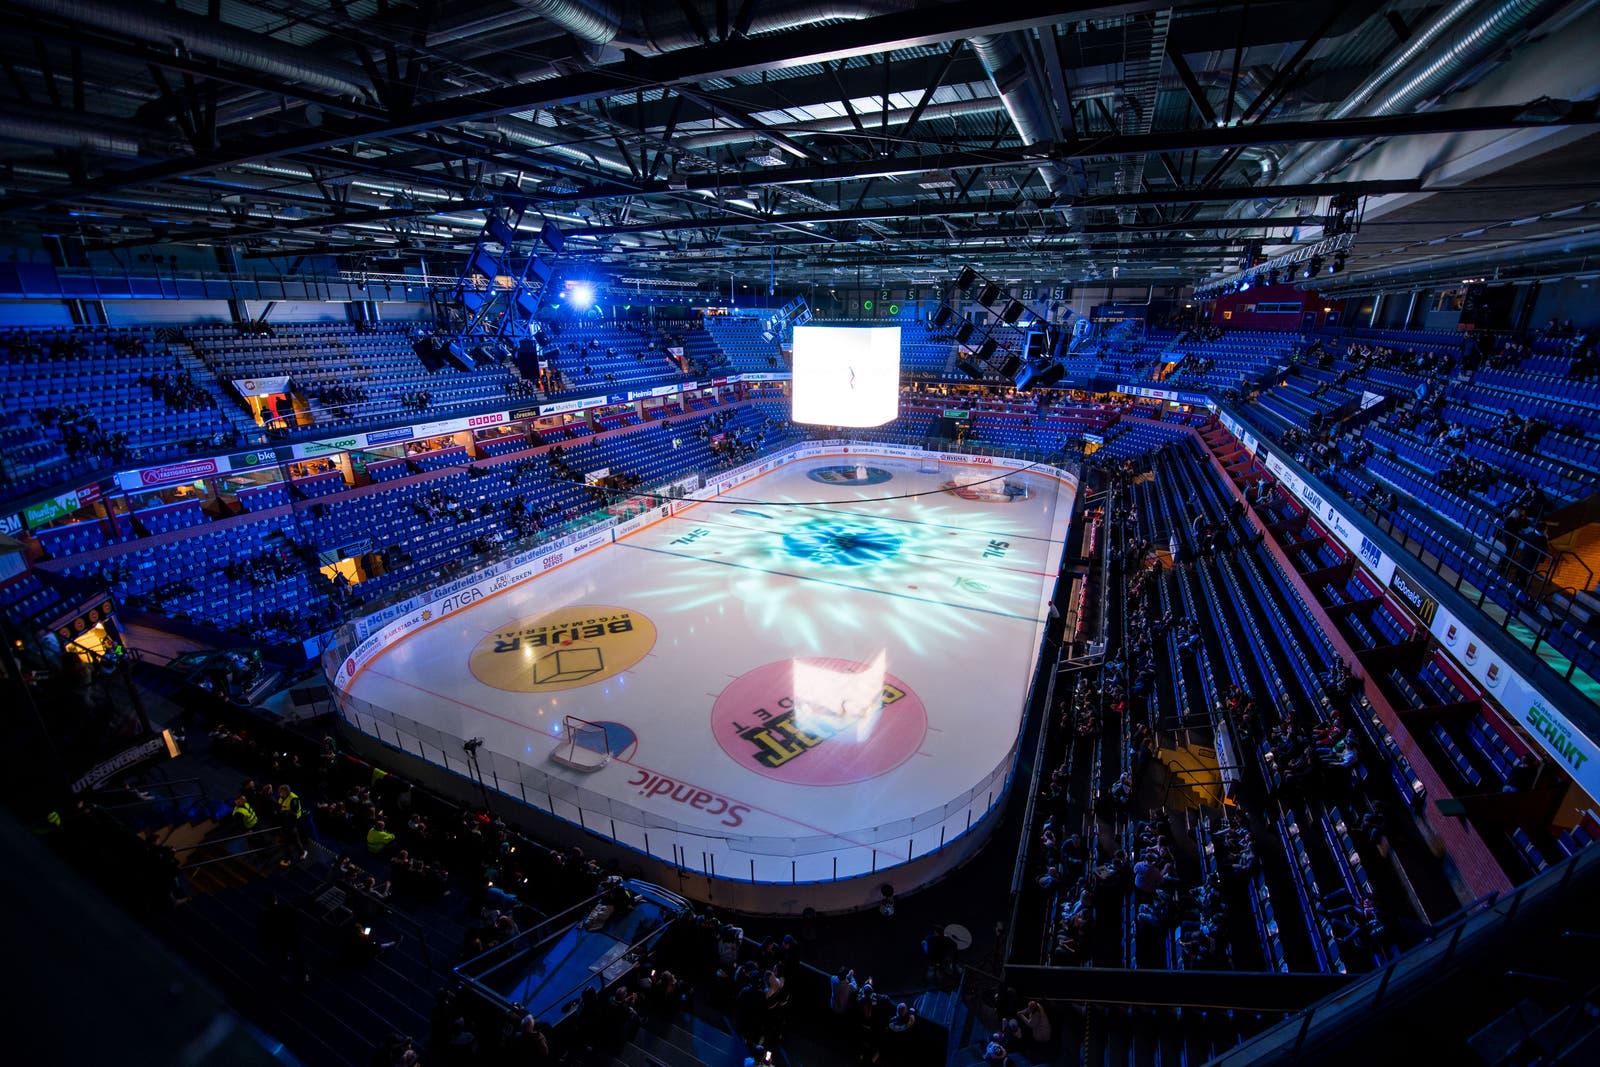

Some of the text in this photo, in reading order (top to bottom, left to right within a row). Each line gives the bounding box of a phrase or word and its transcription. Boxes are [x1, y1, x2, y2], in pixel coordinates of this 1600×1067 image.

[335, 439, 356, 448] coop
[258, 451, 276, 460] bke
[973, 456, 992, 465] JULA
[553, 539, 566, 551] Kyl
[542, 553, 563, 565] Office
[484, 566, 499, 578] Kyl
[441, 587, 484, 615] ATEA
[395, 601, 413, 615] Kyl
[495, 613, 629, 639] BYGGMATERIAL
[493, 618, 634, 653] BEIJER
[1526, 706, 1589, 771] SCHAKT
[627, 769, 750, 828] Scandic
